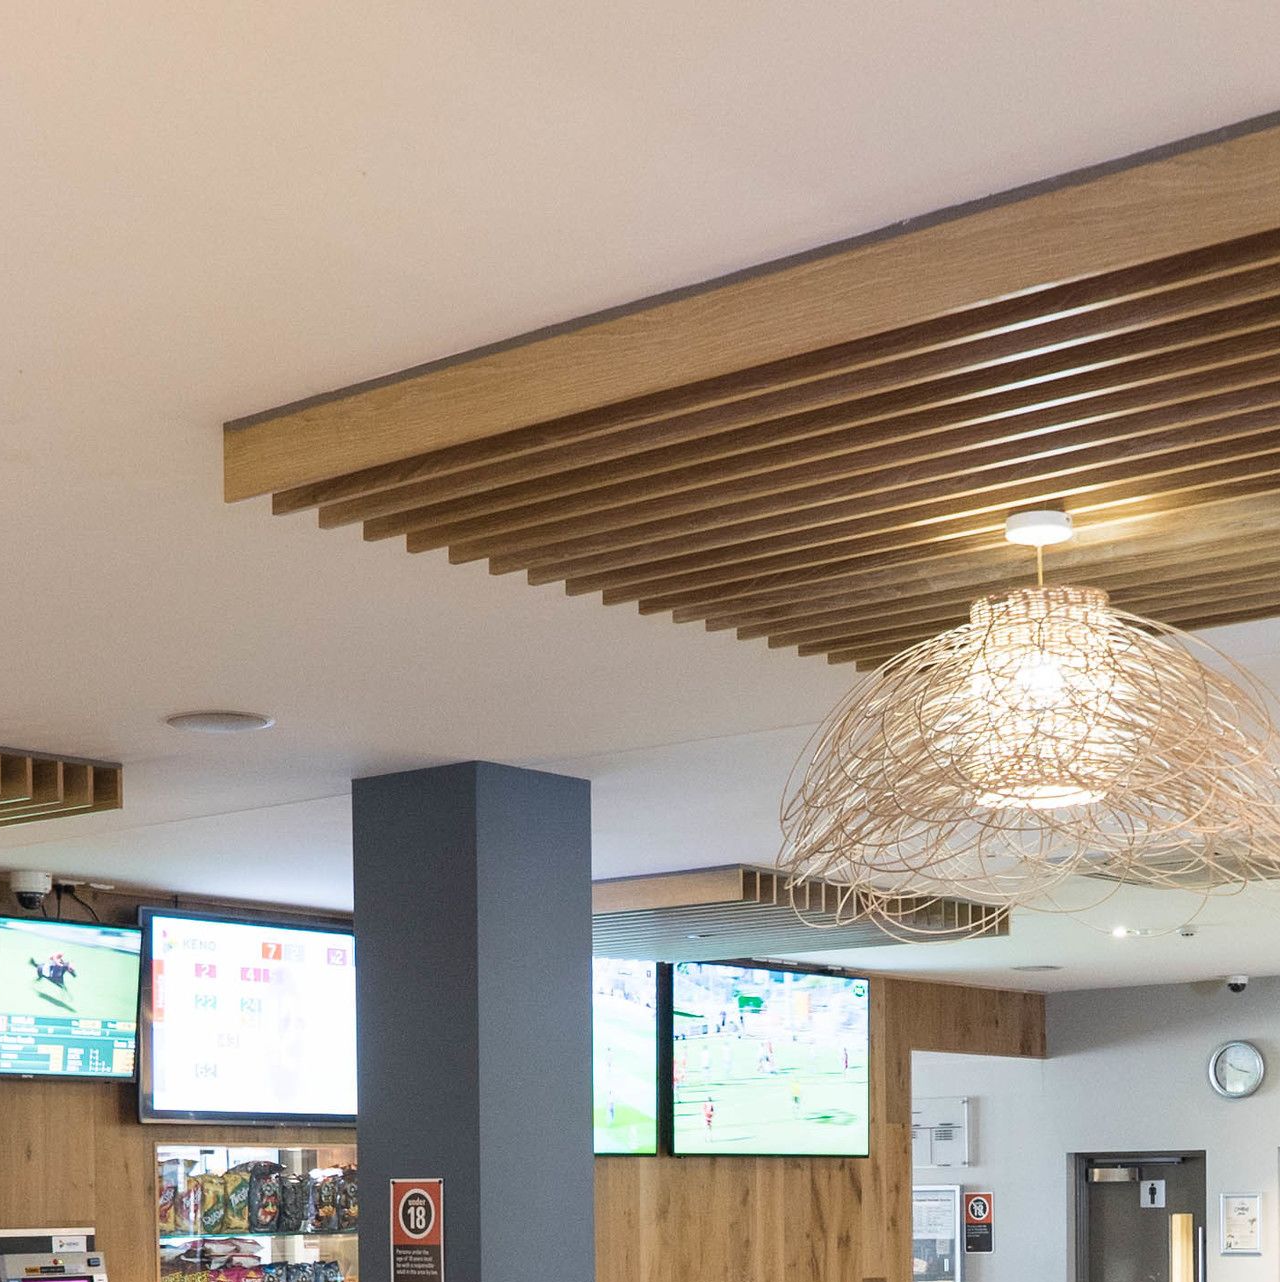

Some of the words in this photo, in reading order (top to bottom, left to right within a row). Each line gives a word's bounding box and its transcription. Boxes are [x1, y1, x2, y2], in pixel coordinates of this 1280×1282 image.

[183, 937, 217, 951] KENO
[408, 1197, 426, 1206] under
[407, 1206, 426, 1230] 18
